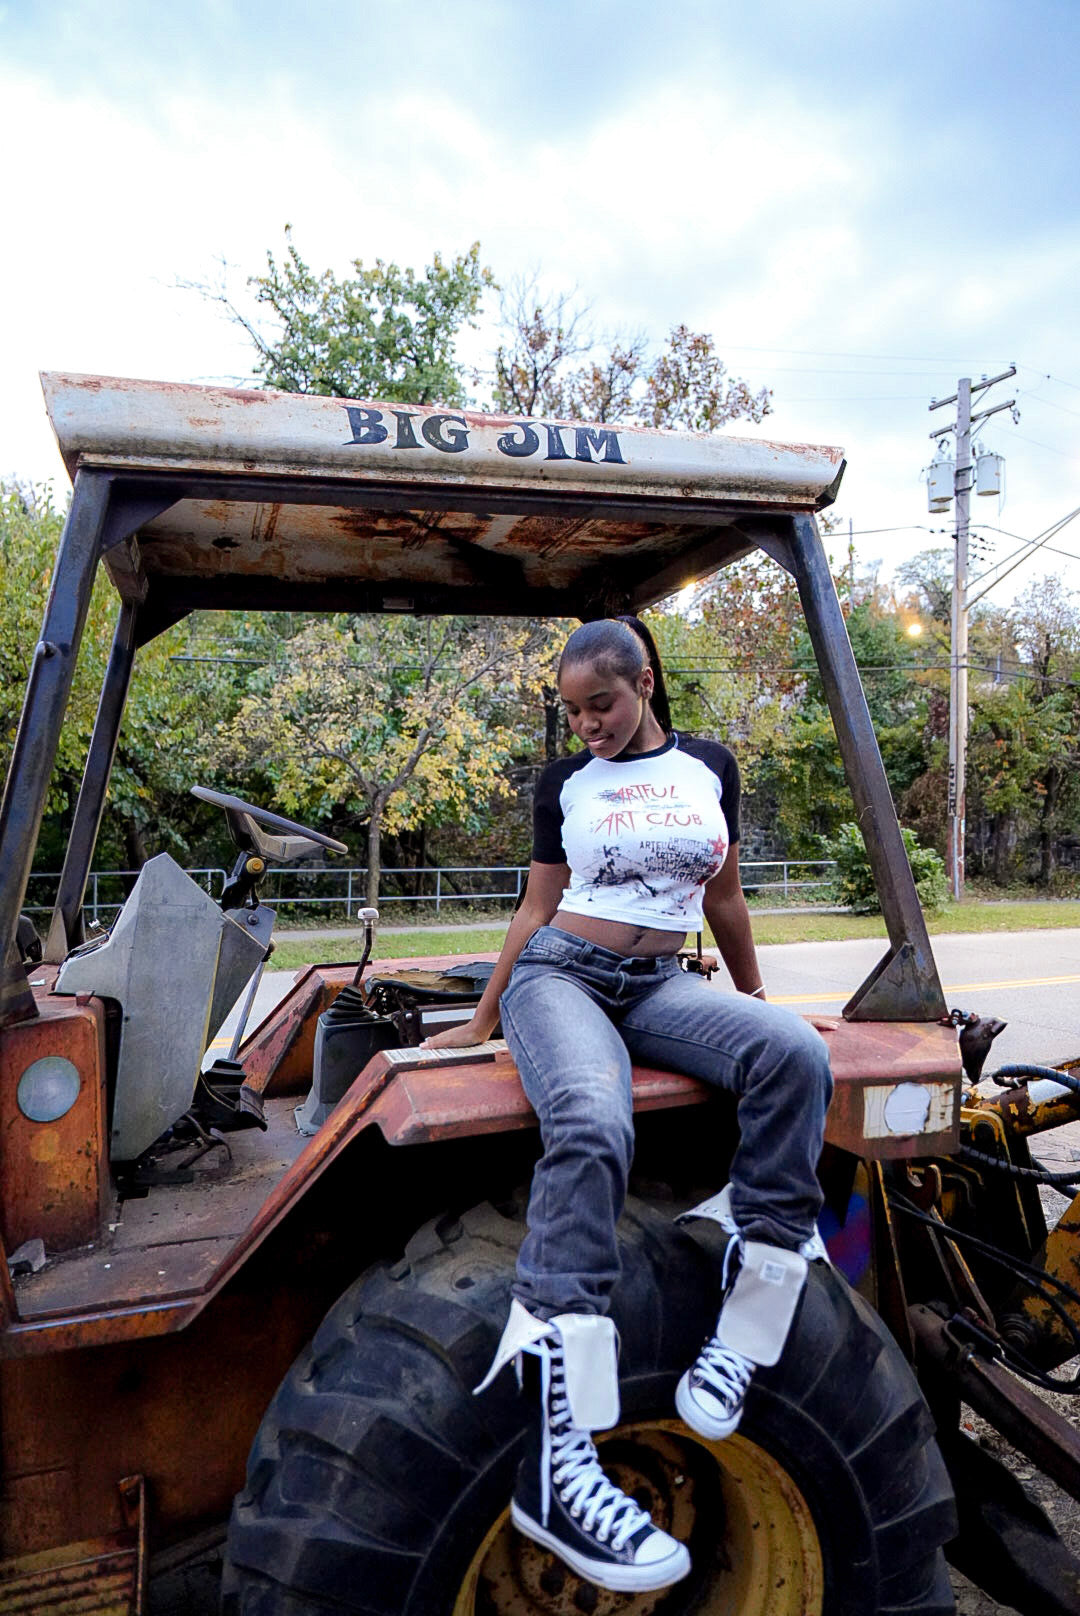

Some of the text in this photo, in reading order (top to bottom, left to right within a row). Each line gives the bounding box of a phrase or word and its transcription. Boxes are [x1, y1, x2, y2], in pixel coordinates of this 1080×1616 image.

[341, 405, 629, 465] BIG JIM
[607, 784, 680, 805] ARTFUL
[594, 810, 703, 837] ART CLUB
